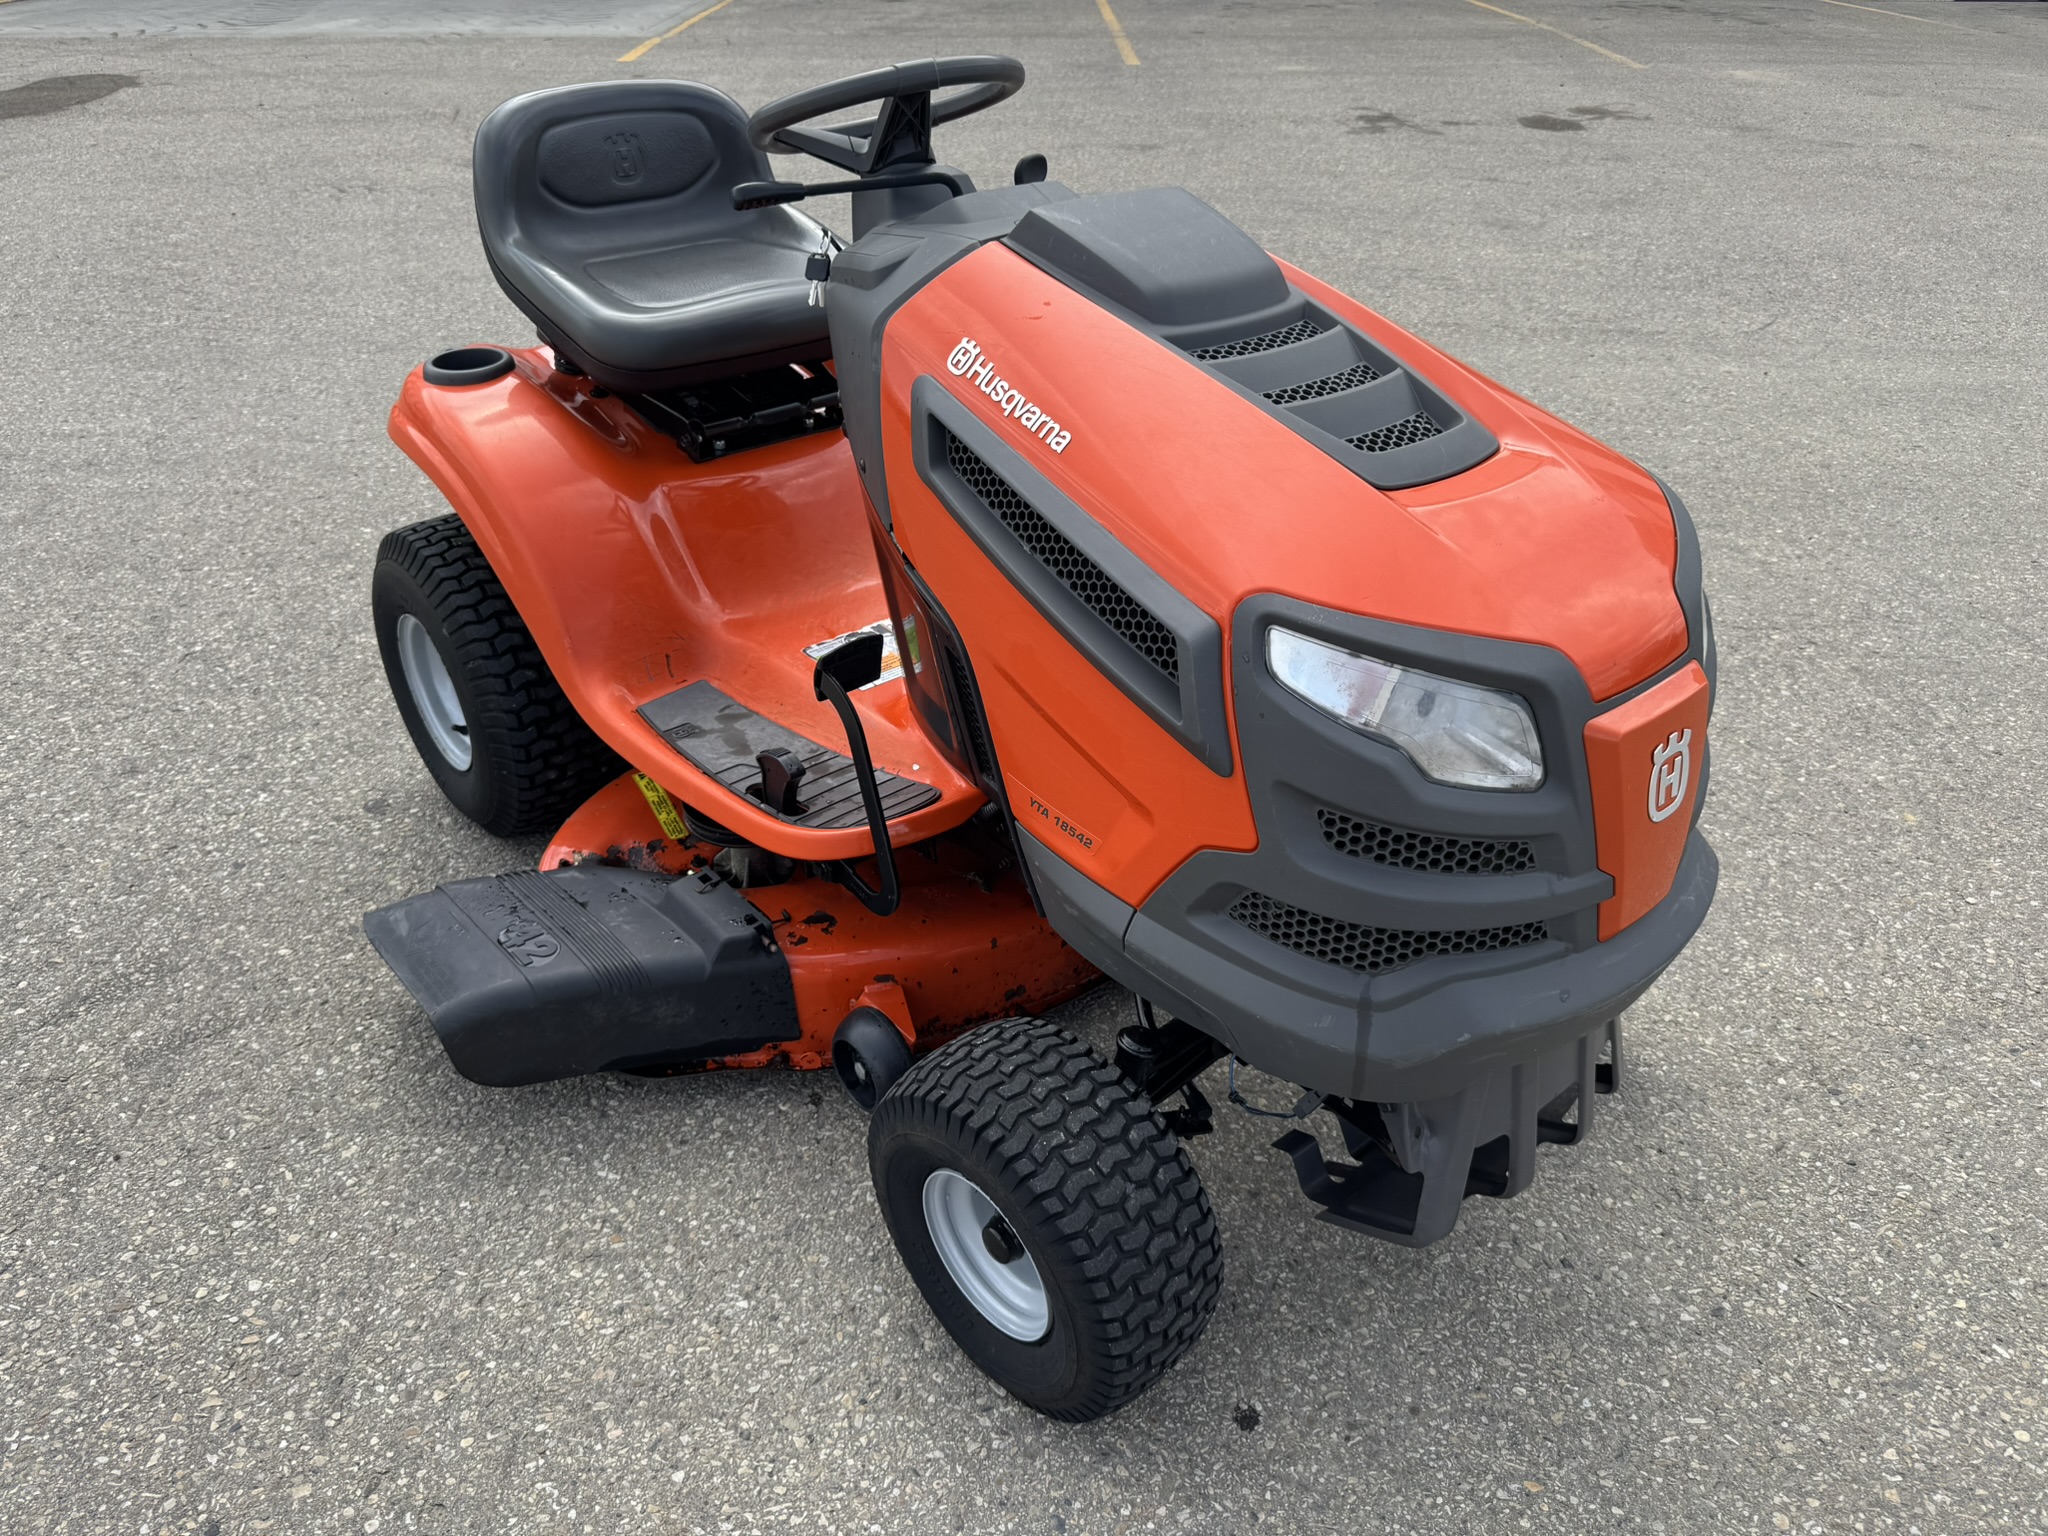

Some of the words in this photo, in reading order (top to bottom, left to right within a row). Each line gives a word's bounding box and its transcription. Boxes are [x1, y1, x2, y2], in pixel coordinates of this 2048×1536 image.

[966, 355, 1072, 454] Husqvarna
[1029, 796, 1050, 819] YTA
[1053, 816, 1094, 849] 18542
[500, 920, 560, 968] 42
